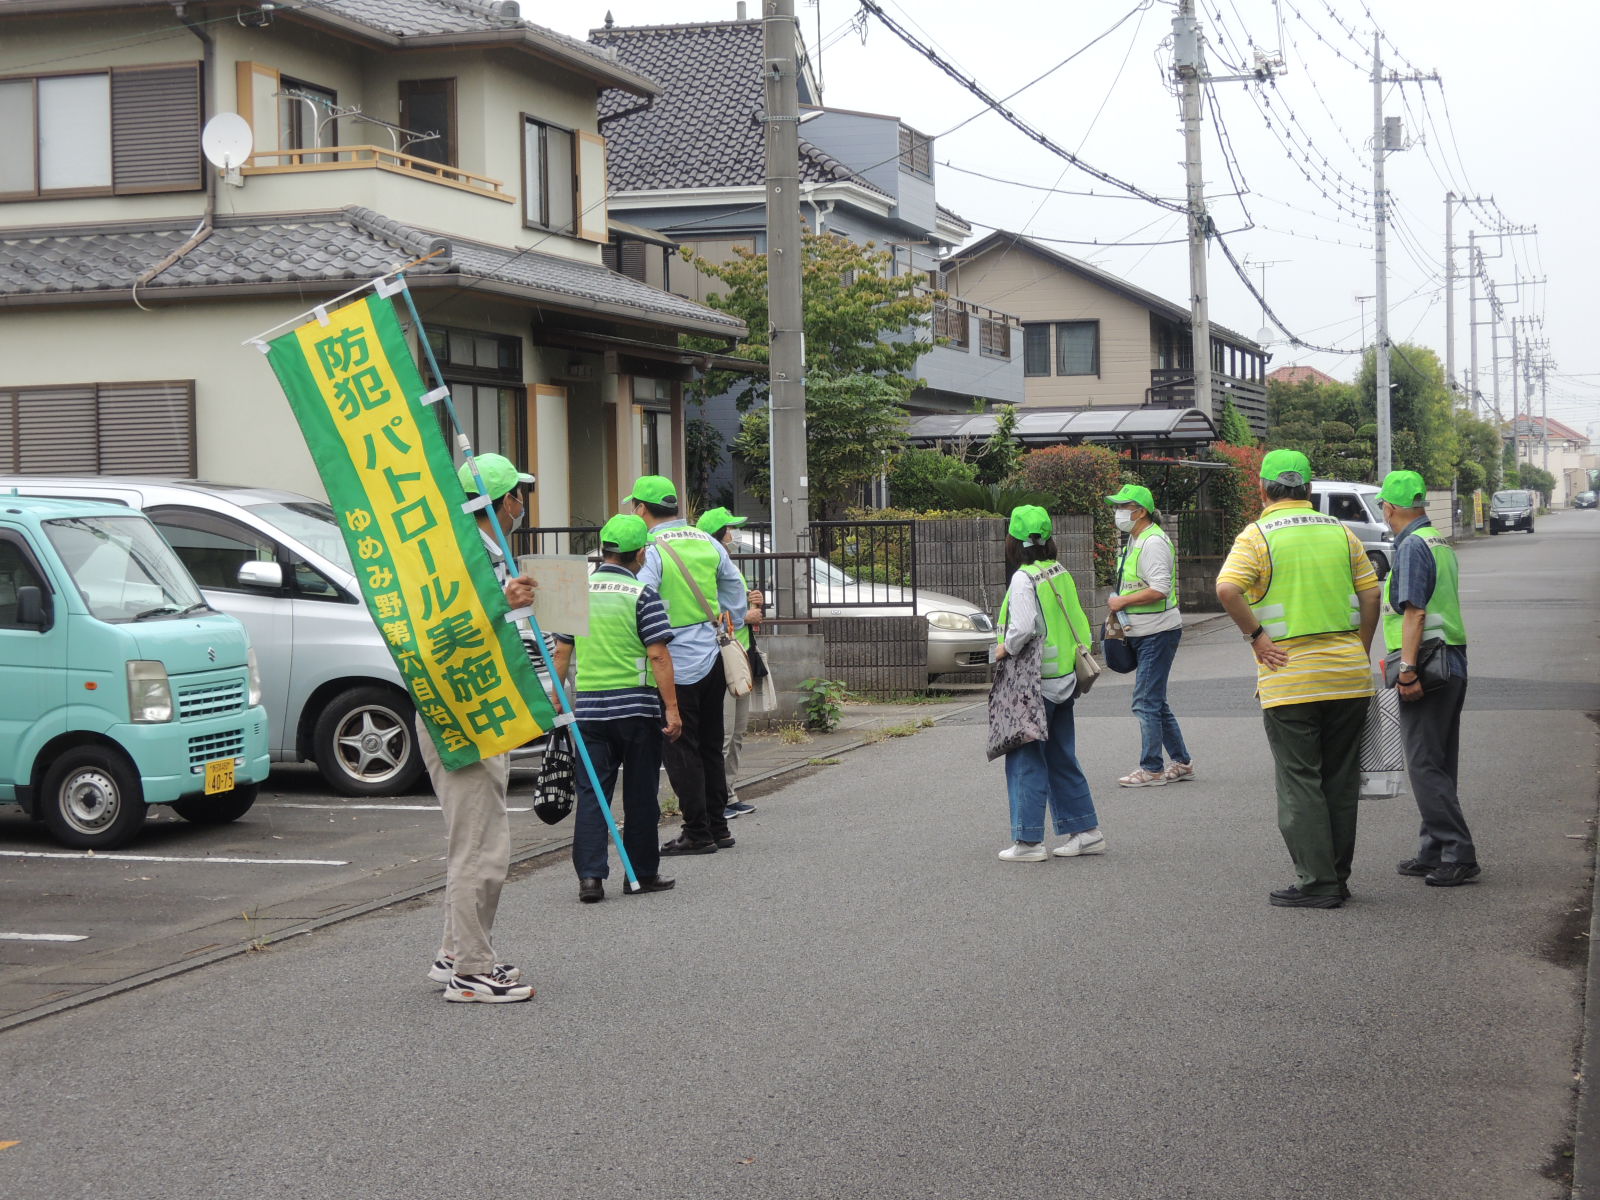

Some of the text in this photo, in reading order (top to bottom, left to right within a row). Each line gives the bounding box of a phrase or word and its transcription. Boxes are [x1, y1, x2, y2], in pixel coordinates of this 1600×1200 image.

[314, 326, 516, 738] 防犯パトロール実施中
[345, 508, 470, 753] ゆめみ野第六自治会
[211, 771, 233, 791] 40-75
